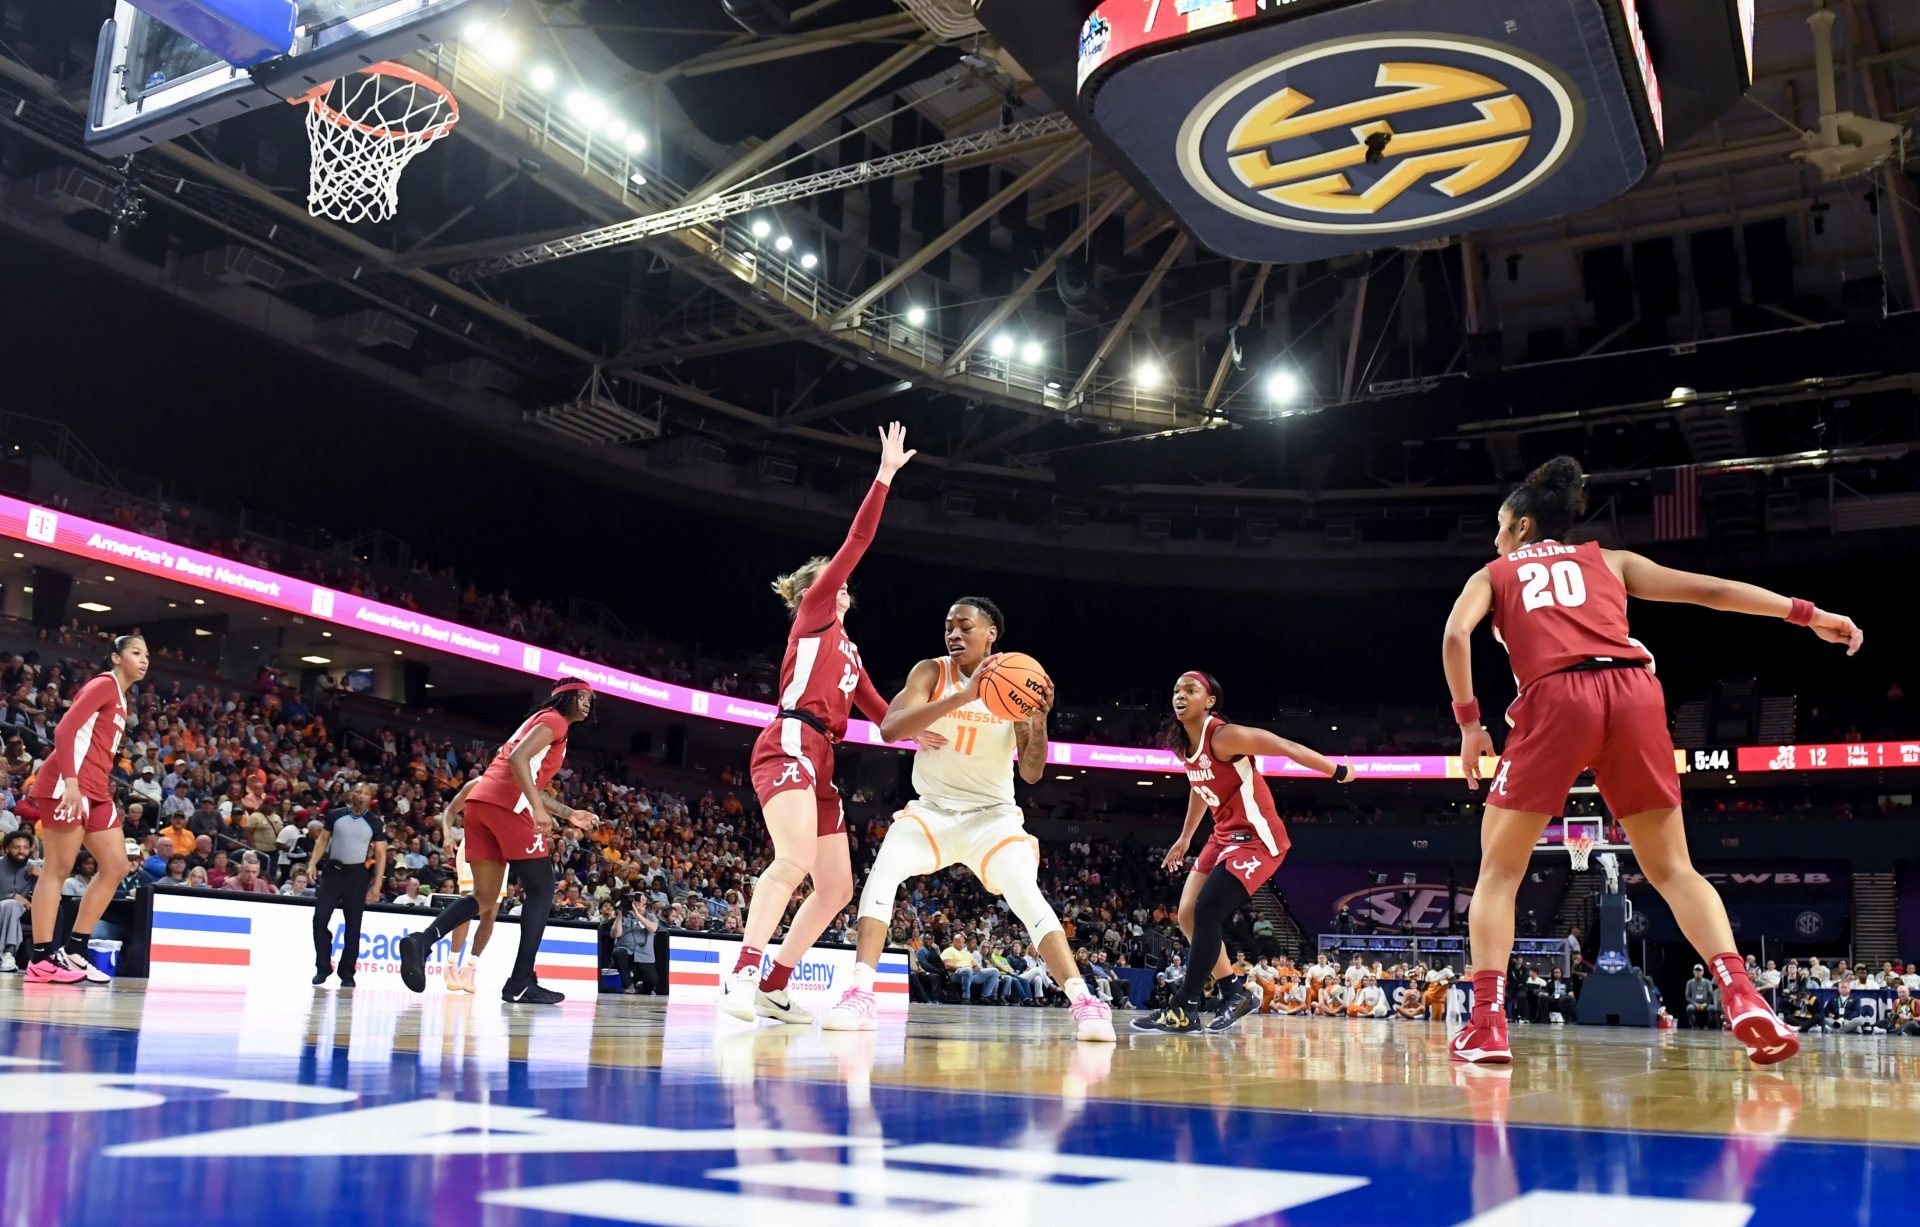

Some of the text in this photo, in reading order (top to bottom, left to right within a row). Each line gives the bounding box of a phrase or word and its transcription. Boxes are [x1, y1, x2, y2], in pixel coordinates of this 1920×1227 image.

[1507, 544, 1577, 562] COLLINS
[87, 532, 282, 597] America's Best Network
[1516, 560, 1587, 613] 20
[355, 606, 421, 635] America's
[450, 631, 501, 656] Network
[954, 724, 978, 756] 11
[1089, 750, 1145, 765] America's
[1370, 761, 1422, 772] Network
[1694, 749, 1730, 771] 5:44
[1809, 747, 1828, 767] 12
[1357, 889, 1474, 928] SE
[1799, 915, 1819, 935] SEC
[791, 983, 827, 992] OUTDOORS
